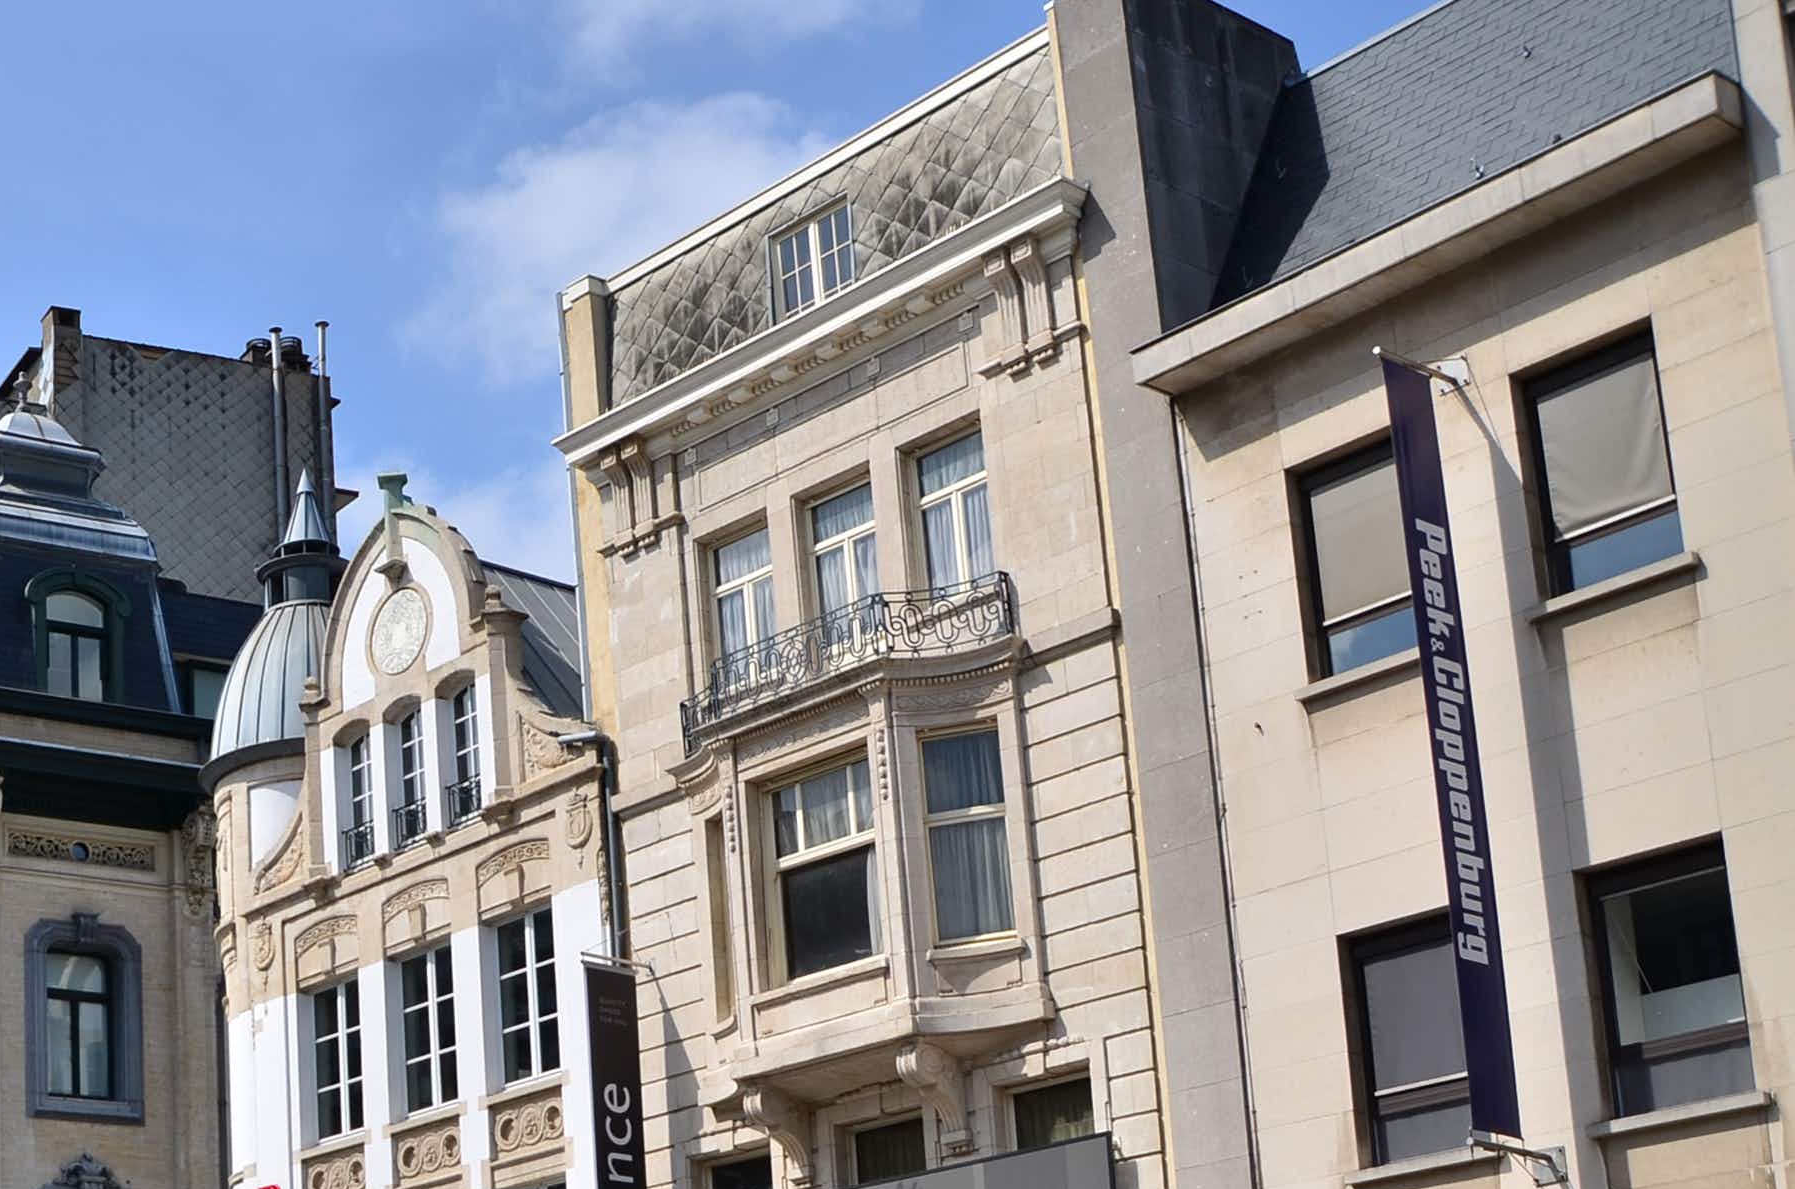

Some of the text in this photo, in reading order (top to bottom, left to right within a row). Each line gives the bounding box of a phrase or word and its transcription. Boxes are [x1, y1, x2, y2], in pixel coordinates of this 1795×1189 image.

[1415, 517, 1490, 966] Peek & Cloppenburg
